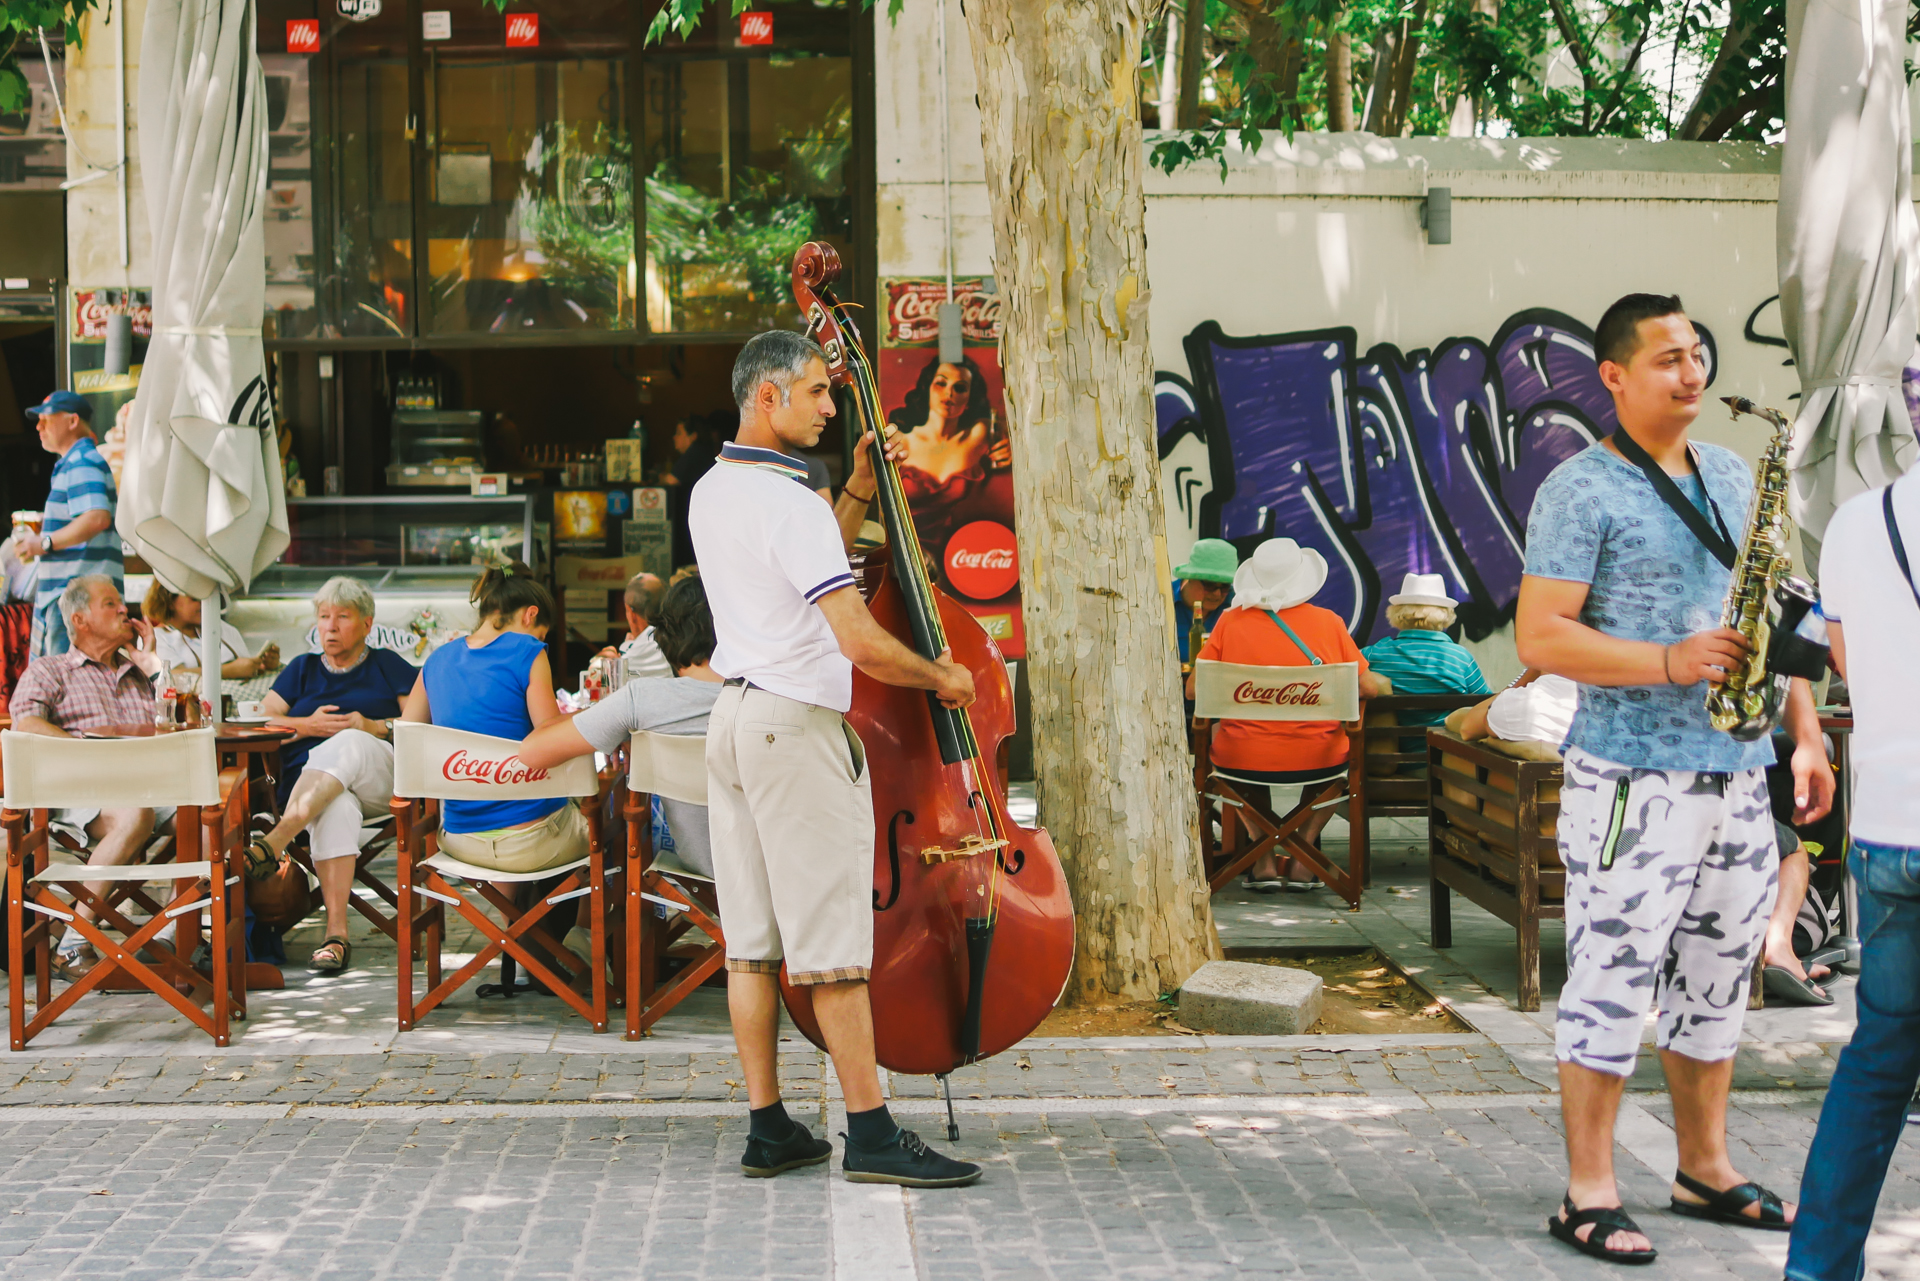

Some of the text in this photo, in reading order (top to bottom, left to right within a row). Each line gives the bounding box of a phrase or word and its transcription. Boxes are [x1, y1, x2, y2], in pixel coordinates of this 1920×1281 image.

[289, 23, 317, 48] illy
[508, 17, 537, 42] illy
[742, 16, 771, 40] illy
[898, 322, 913, 339] 5
[951, 548, 1014, 568] Coca-Cola
[983, 620, 1008, 636] KE
[1233, 680, 1324, 706] Coca-Cola
